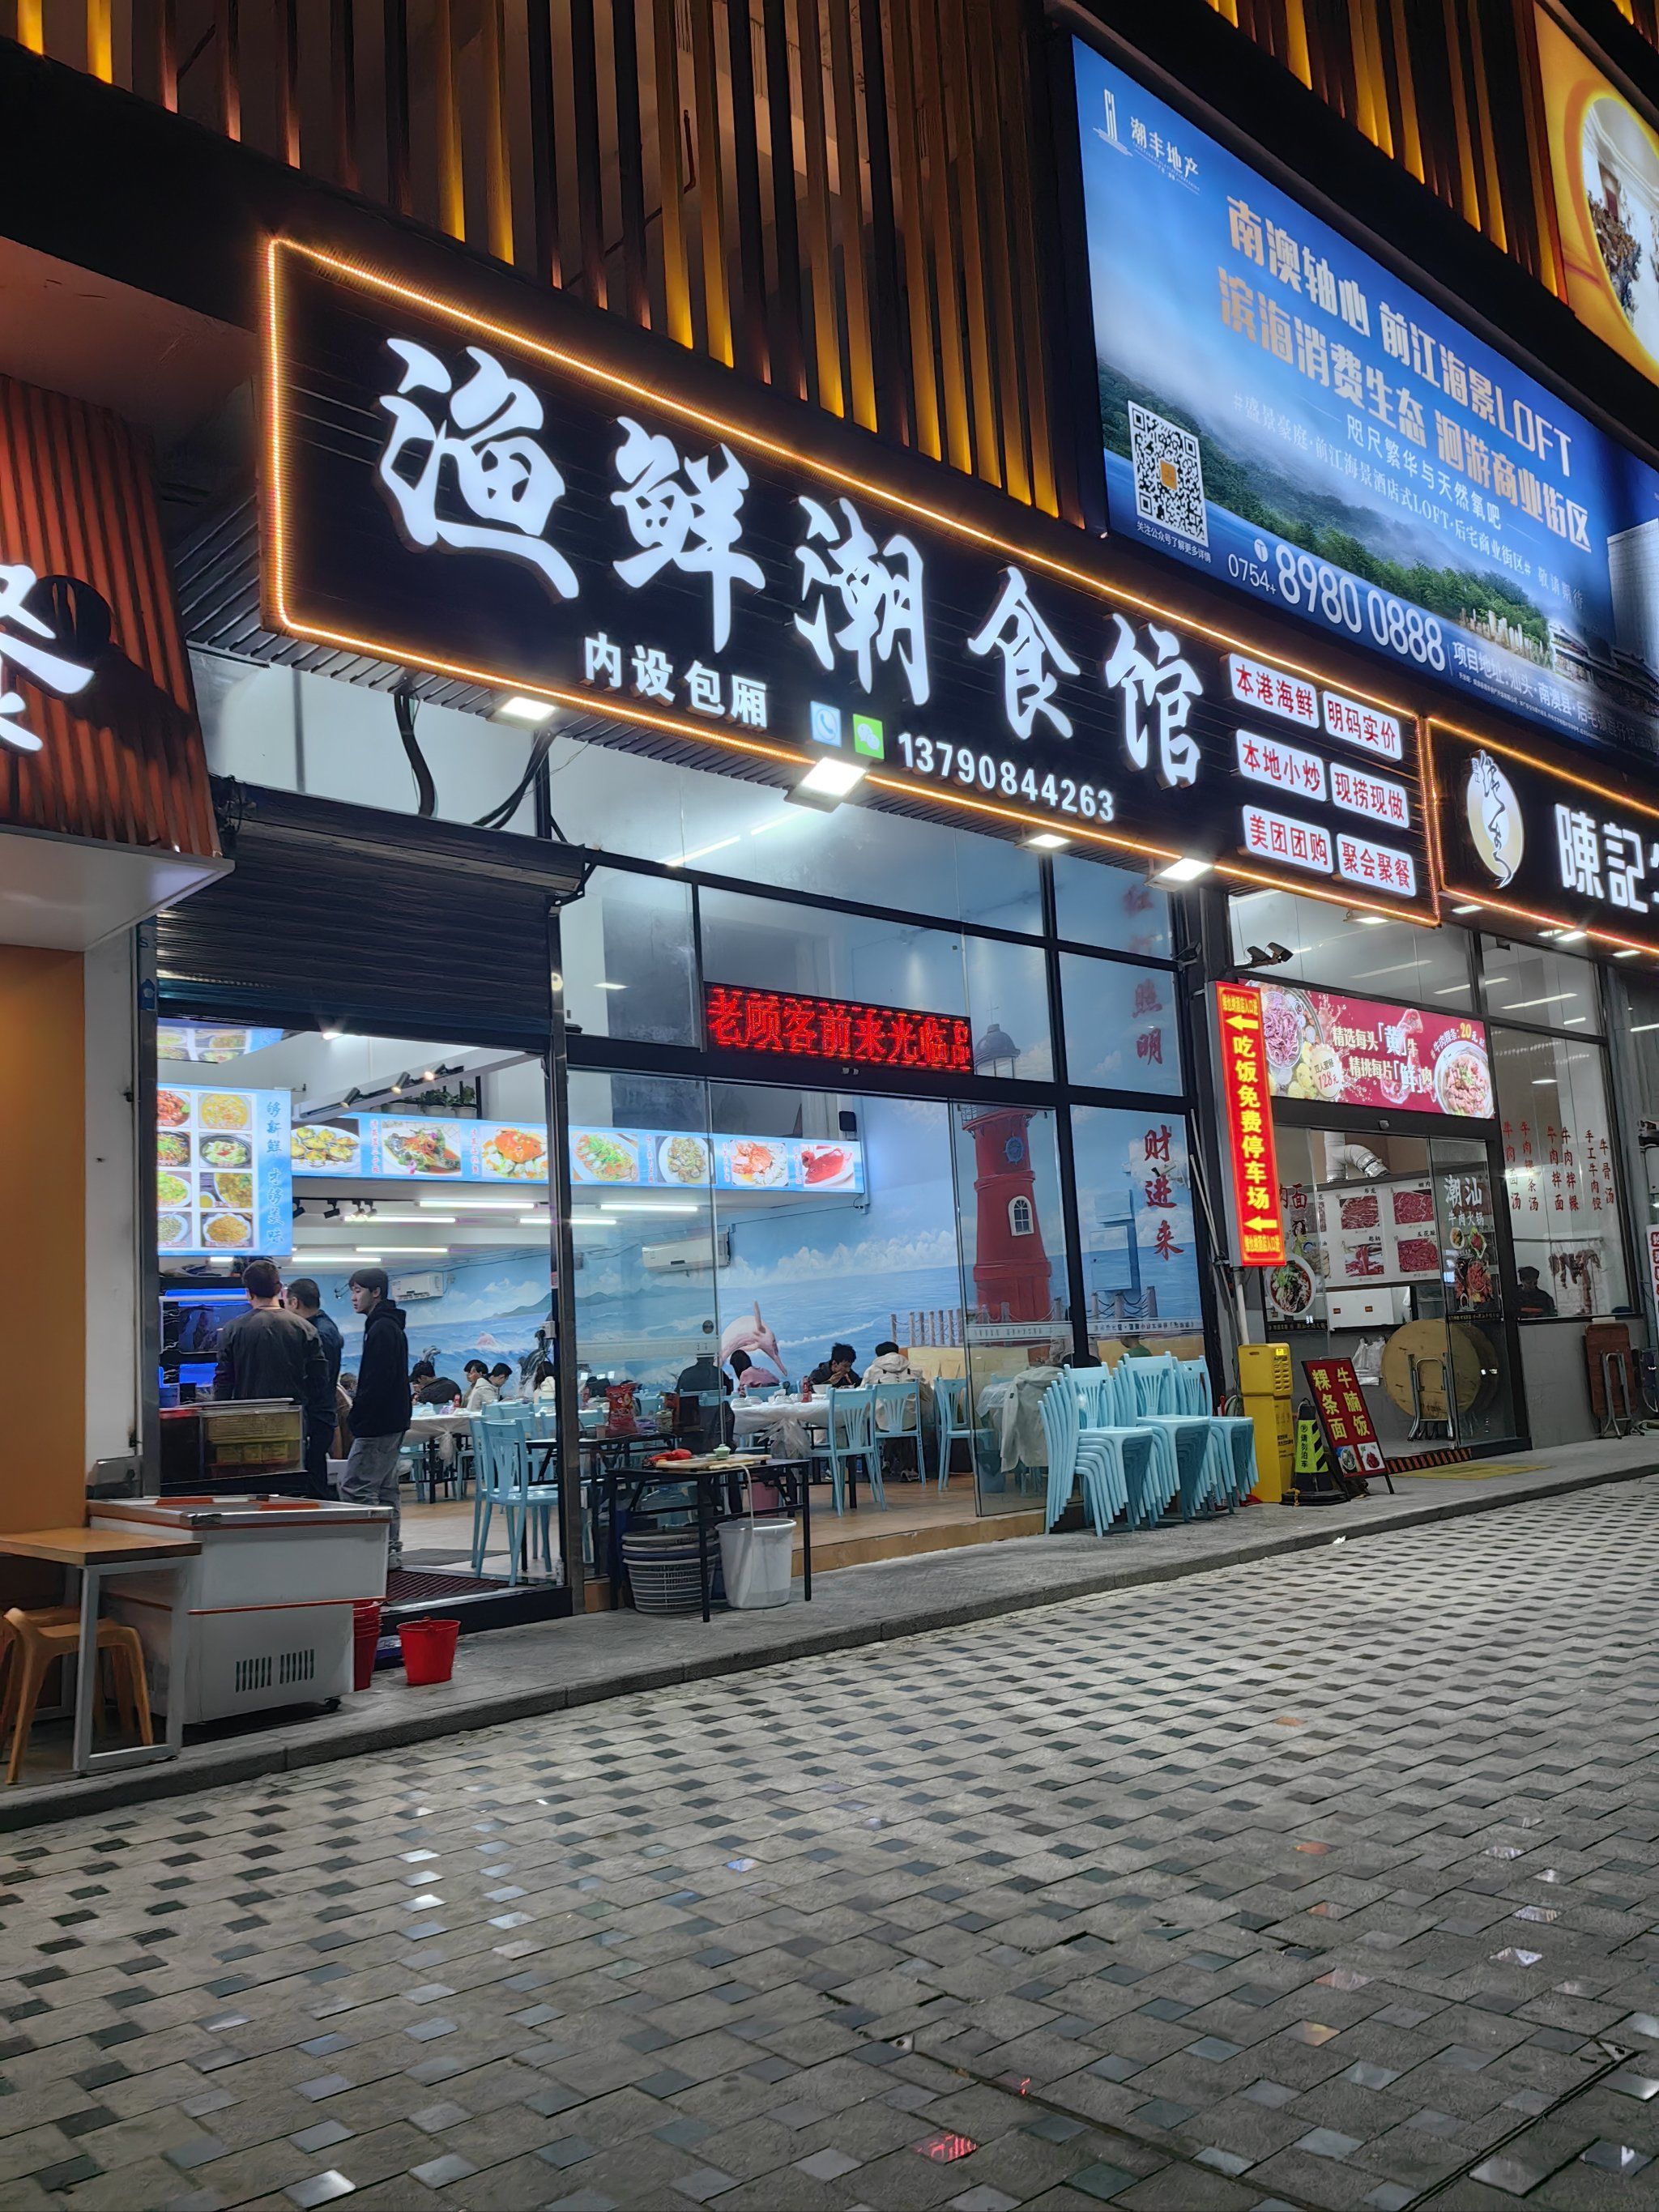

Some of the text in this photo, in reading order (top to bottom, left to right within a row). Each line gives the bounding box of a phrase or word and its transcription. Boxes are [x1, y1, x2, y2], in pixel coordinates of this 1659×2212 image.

[1130, 116, 1199, 178] 潮丰地产
[1218, 266, 1427, 449] 滨海消费生态
[1227, 195, 1572, 477] 南澳轴心 前江海景LOFT
[1347, 415, 1502, 531] 咫尺繁华与天然氧吧
[1137, 521, 1211, 564] 关注公众号了解更多详情
[1275, 544, 1362, 634] 8980
[1367, 589, 1447, 673] 0888
[583, 632, 769, 728] 内设包厢
[1235, 664, 1314, 721] 本港海鲜
[1328, 700, 1396, 752] 明码实价
[898, 732, 1115, 821] 13790844263
[1242, 739, 1404, 821] 本地小炒 现捞现做
[1250, 814, 1410, 889] 美团团购 聚会聚餐
[1554, 803, 1659, 914] 陳記
[1232, 1035, 1271, 1210] 吃饭免费停车场
[1444, 1174, 1482, 1207] 潮汕
[1547, 1126, 1564, 1211] 牛肉拌面
[1585, 1130, 1602, 1211] 手工牛肉饺
[1600, 1138, 1614, 1204] 牛骨汤
[1448, 1210, 1485, 1226] 牛肉火锅
[1311, 1369, 1348, 1441] 粿条面
[1337, 1367, 1371, 1438] 牛腩饭
[1300, 1434, 1308, 1468] 请勿泊车
